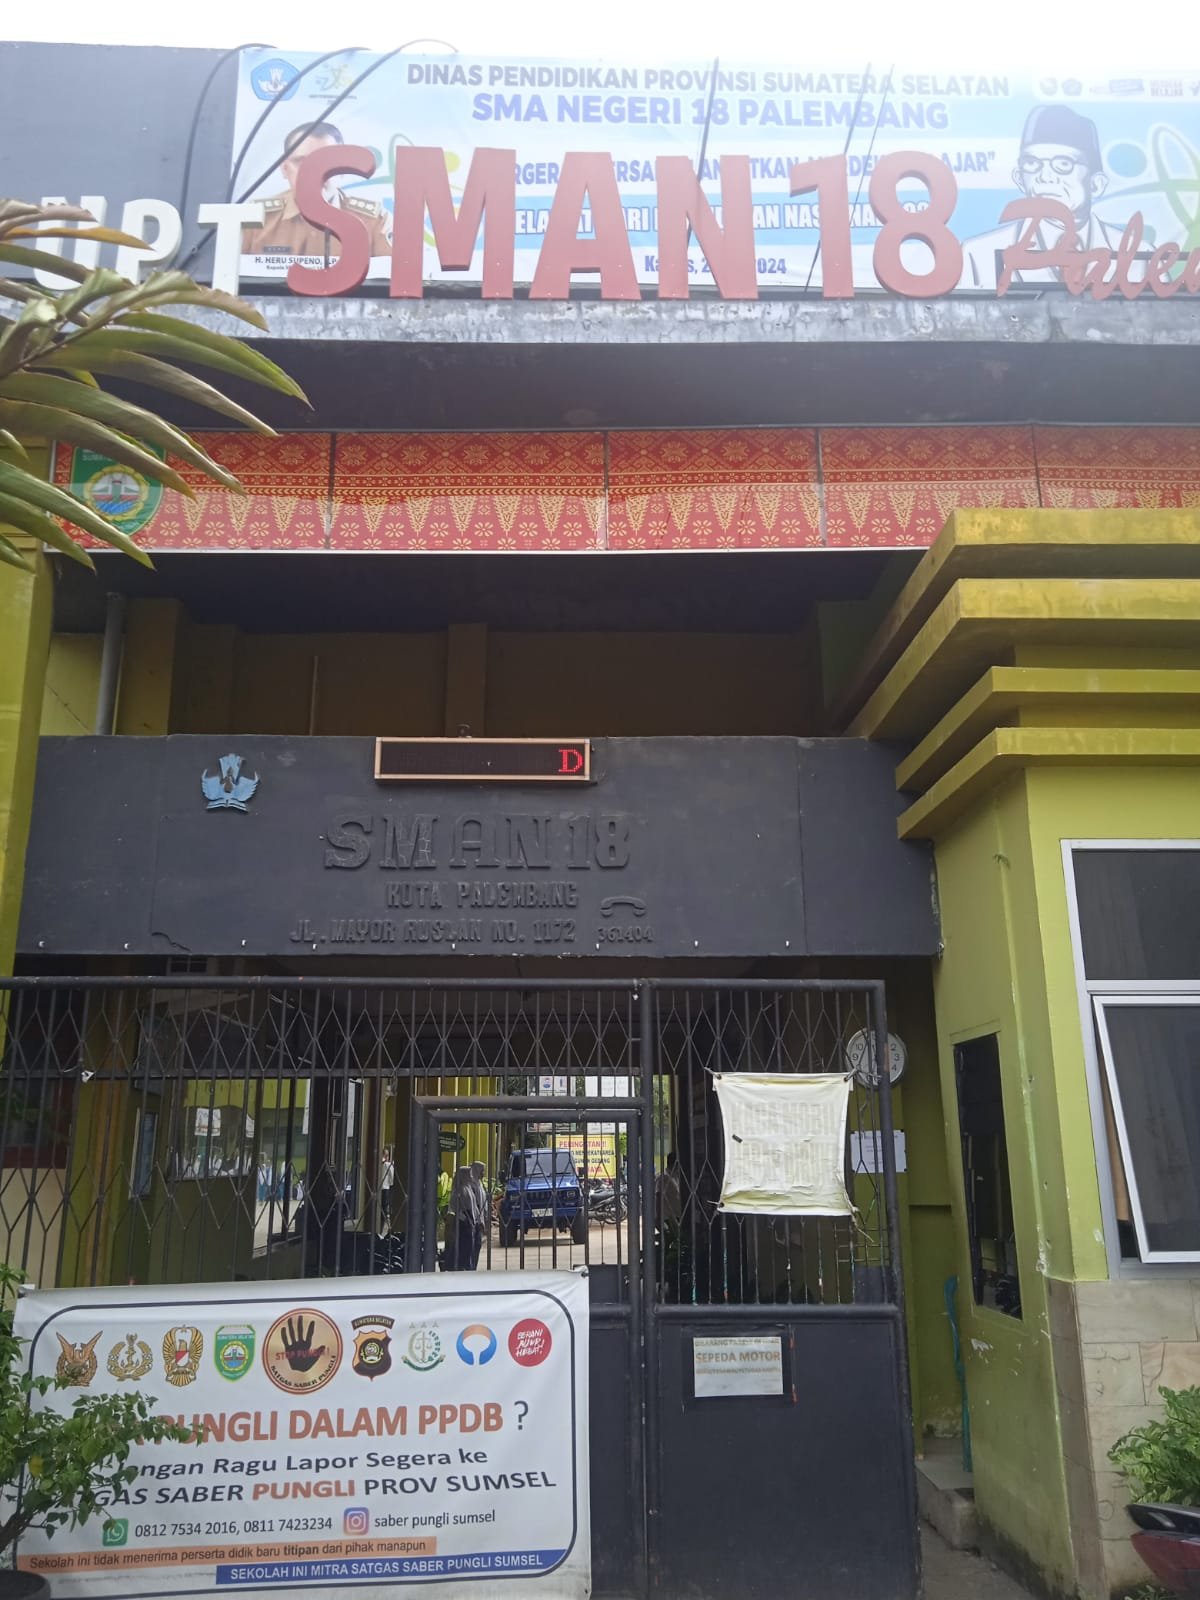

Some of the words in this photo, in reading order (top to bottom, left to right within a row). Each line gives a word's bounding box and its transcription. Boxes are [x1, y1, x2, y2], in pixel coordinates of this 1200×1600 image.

[407, 63, 483, 87] DINAS
[489, 64, 638, 89] PENDIDIKAN
[762, 71, 896, 95] SUMATERA
[901, 74, 1010, 97] SELATAN
[472, 93, 549, 122] SMA
[557, 94, 682, 124] NEGERI
[691, 98, 730, 126] 18
[738, 99, 950, 129] PALEMBANG
[33, 194, 265, 296] UPT
[286, 143, 759, 300] SMAN
[789, 150, 964, 299] 18
[559, 749, 584, 773] D
[324, 812, 552, 870] SMAN
[566, 812, 632, 870] 18
[385, 880, 444, 910] KOTA
[455, 880, 580, 910] PALEMBANG
[329, 917, 397, 945] MAYOR
[401, 917, 483, 945] RUSLAN
[490, 917, 526, 945] NO.
[532, 917, 577, 945] 1172
[852, 1053, 859, 1061] 9
[894, 1053, 900, 1061] 3
[890, 1043, 897, 1051] 2
[695, 1352, 736, 1363] SEPEDA
[739, 1350, 781, 1362] MOTOR
[288, 1405, 408, 1441] DALAM
[418, 1402, 504, 1435] PPDB
[513, 1400, 529, 1431] ?
[213, 1457, 277, 1476] Ragu
[286, 1454, 359, 1474] Lapor
[366, 1450, 452, 1470] Segera
[458, 1448, 489, 1464] ke
[155, 1484, 245, 1505] SABER
[252, 1479, 355, 1500] PUNGLI
[364, 1476, 438, 1495] PROV
[446, 1471, 557, 1493] SUMSEL
[135, 1523, 167, 1538] 0812
[171, 1522, 202, 1537] 7534
[205, 1521, 239, 1537] 2016,
[243, 1520, 273, 1534] 0811
[278, 1516, 333, 1532] 7423234
[374, 1511, 407, 1528] saber
[412, 1510, 449, 1529] pungli
[452, 1509, 496, 1526] sumsel
[29, 1556, 75, 1569] Sekolah
[77, 1555, 91, 1567] ini
[94, 1554, 119, 1566] tidak
[123, 1551, 178, 1564] menerima
[181, 1549, 225, 1564] perserta
[228, 1546, 253, 1558] didik
[256, 1544, 280, 1557] baru
[283, 1543, 319, 1559] titipan
[322, 1541, 343, 1555] dari
[345, 1541, 374, 1556] pihak
[376, 1540, 426, 1556] manapun
[230, 1566, 289, 1581] SEKOLAH
[292, 1565, 308, 1578] INI
[311, 1563, 349, 1577] MITRA
[351, 1561, 400, 1575] SATGAS
[402, 1559, 444, 1573] SABER
[447, 1556, 492, 1570] PUNGLI
[494, 1553, 543, 1568] SUMSEL
